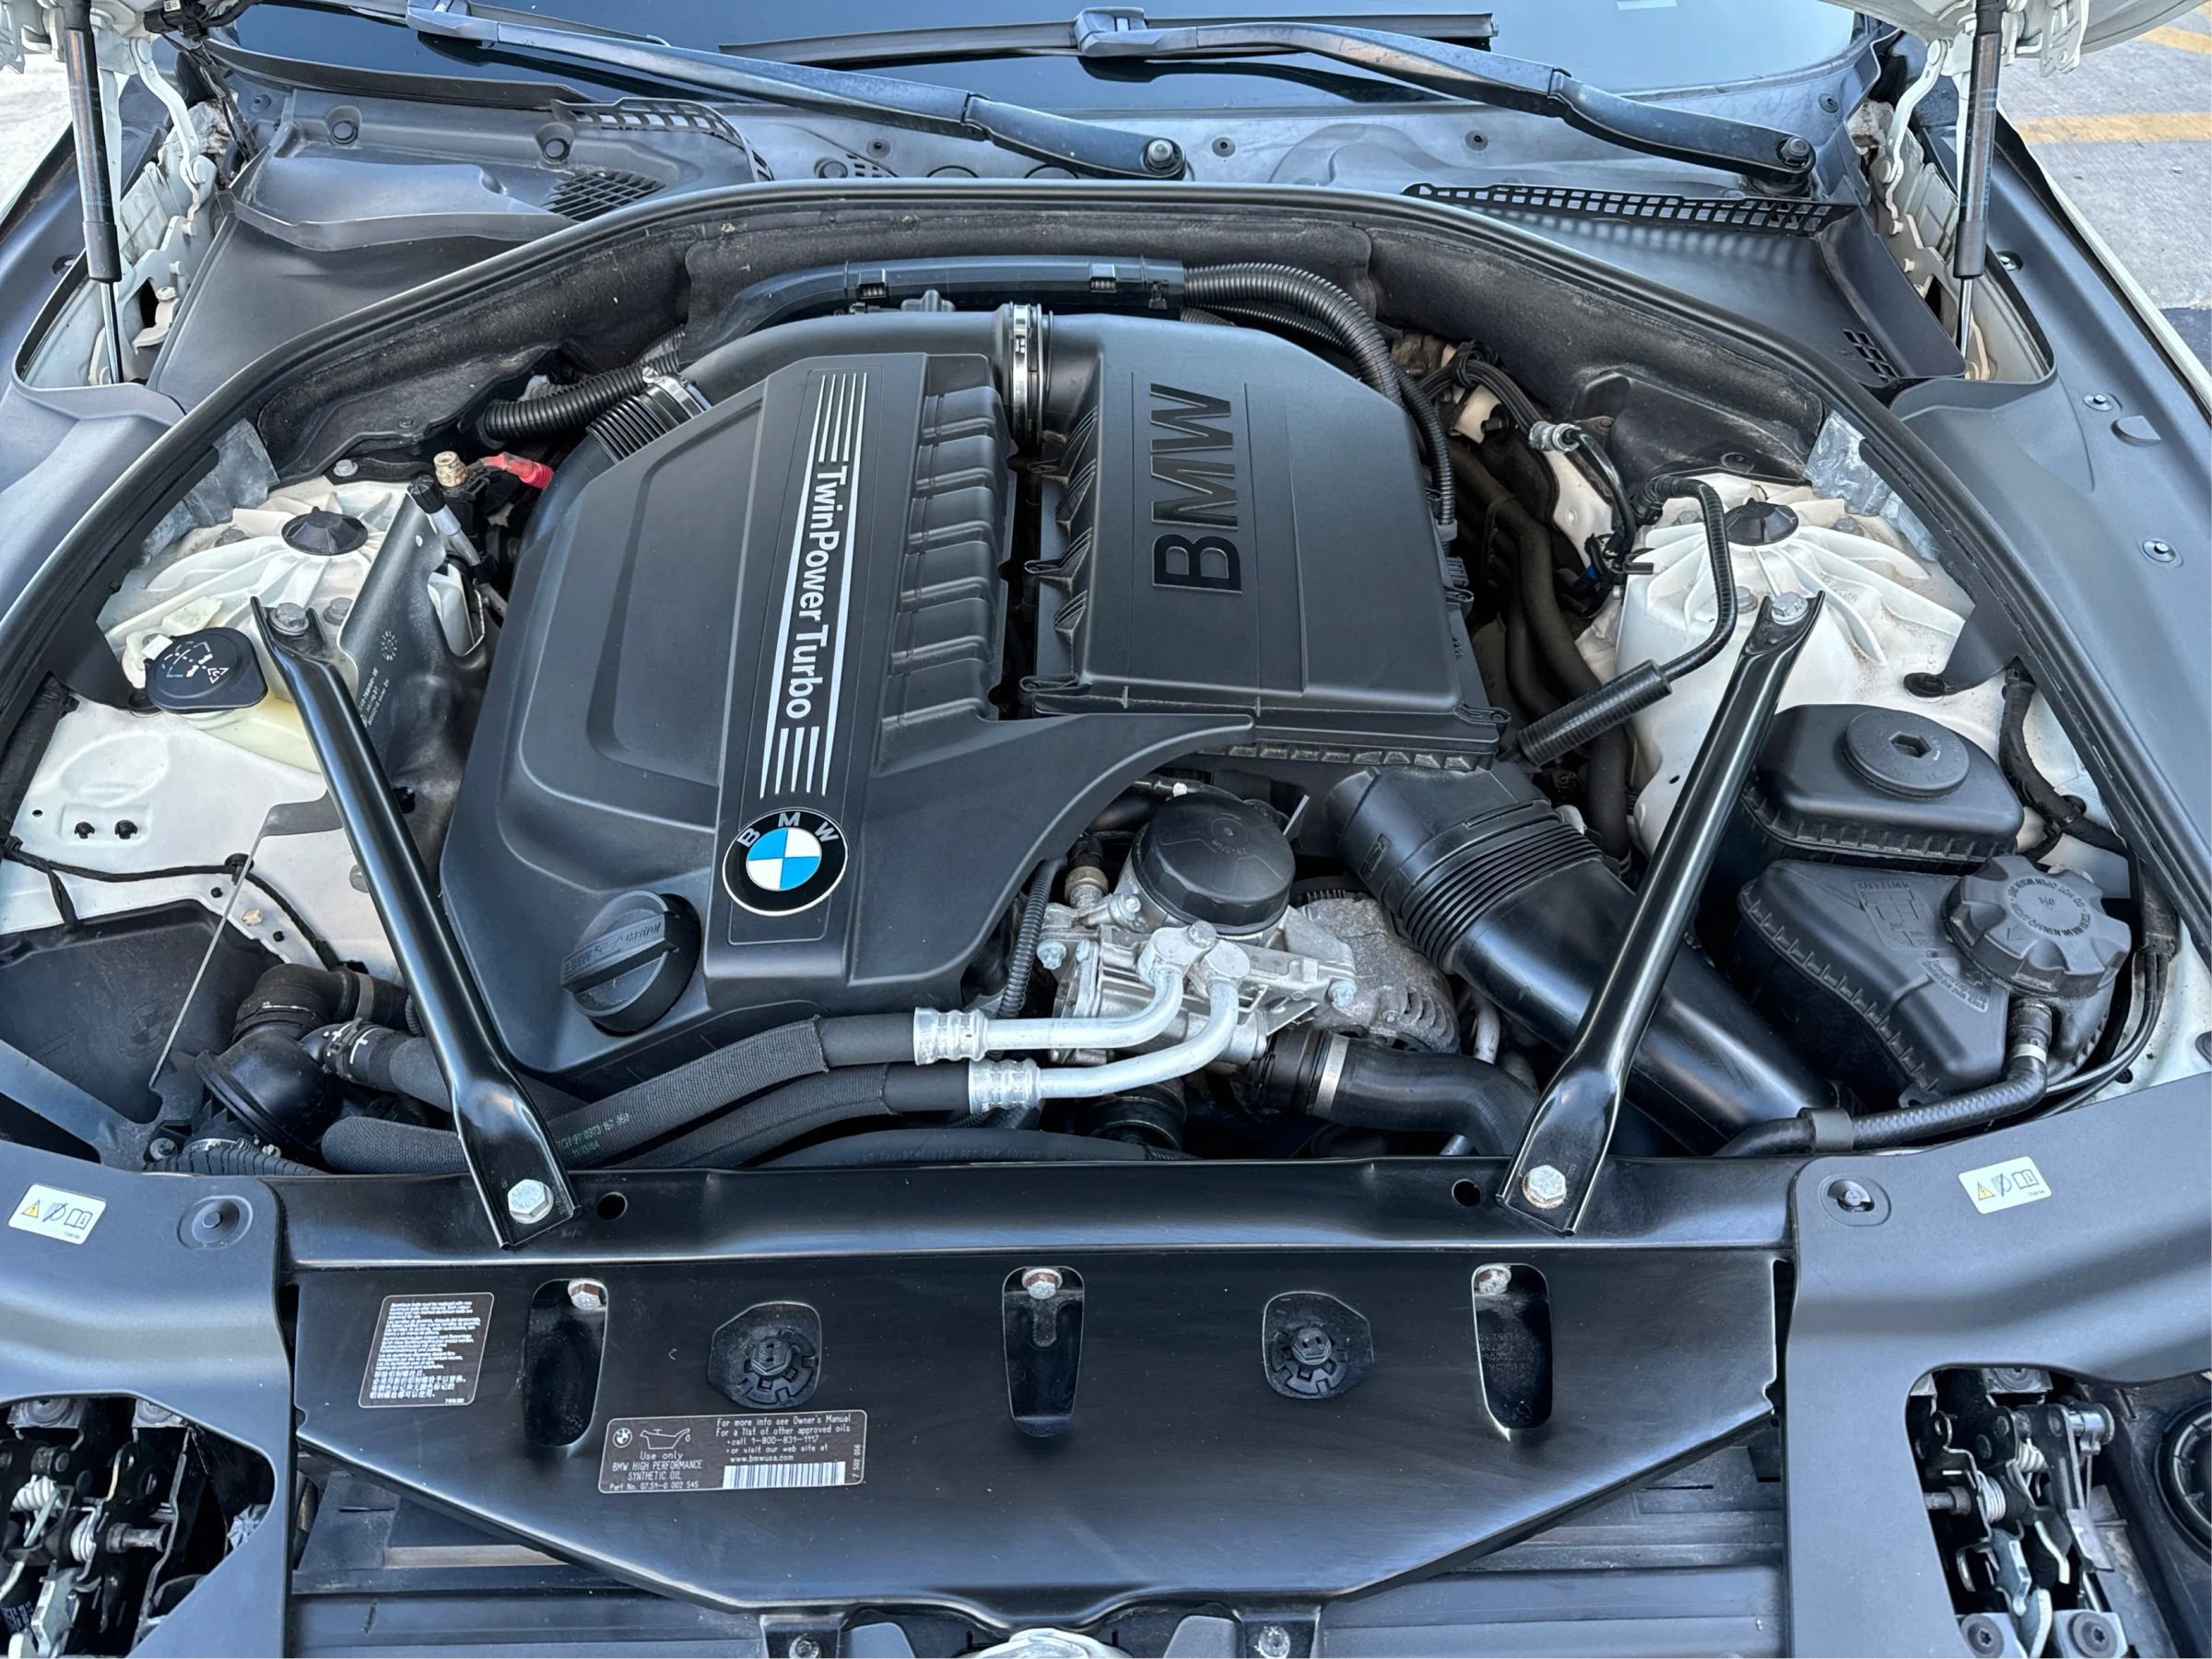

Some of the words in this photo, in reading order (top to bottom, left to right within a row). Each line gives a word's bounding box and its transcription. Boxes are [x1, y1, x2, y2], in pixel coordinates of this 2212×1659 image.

[1150, 382, 1242, 594] BMW
[799, 465, 848, 623] TwinPower
[786, 624, 830, 719] Turbo
[737, 812, 840, 848] BMW
[717, 1418, 730, 1427] For
[757, 1417, 772, 1426] info
[793, 1415, 822, 1425] Owner's
[825, 1413, 852, 1423] Manual
[715, 1427, 729, 1437] For
[742, 1427, 756, 1436] list
[759, 1427, 770, 1436] of
[772, 1426, 794, 1435] other
[797, 1424, 831, 1436] approved
[835, 1423, 851, 1432] oils
[743, 1445, 761, 1453] visit
[800, 1444, 816, 1453] site
[819, 1442, 829, 1452] at
[640, 1451, 656, 1461] Use
[662, 1450, 683, 1463] only
[730, 1454, 794, 1463] www.bmwusa.com
[612, 1462, 629, 1472] BMW
[632, 1461, 650, 1471] HIGH
[653, 1459, 702, 1470] PERFORMANCE
[628, 1471, 666, 1481] SYNTHETIC
[669, 1470, 682, 1480] OIL
